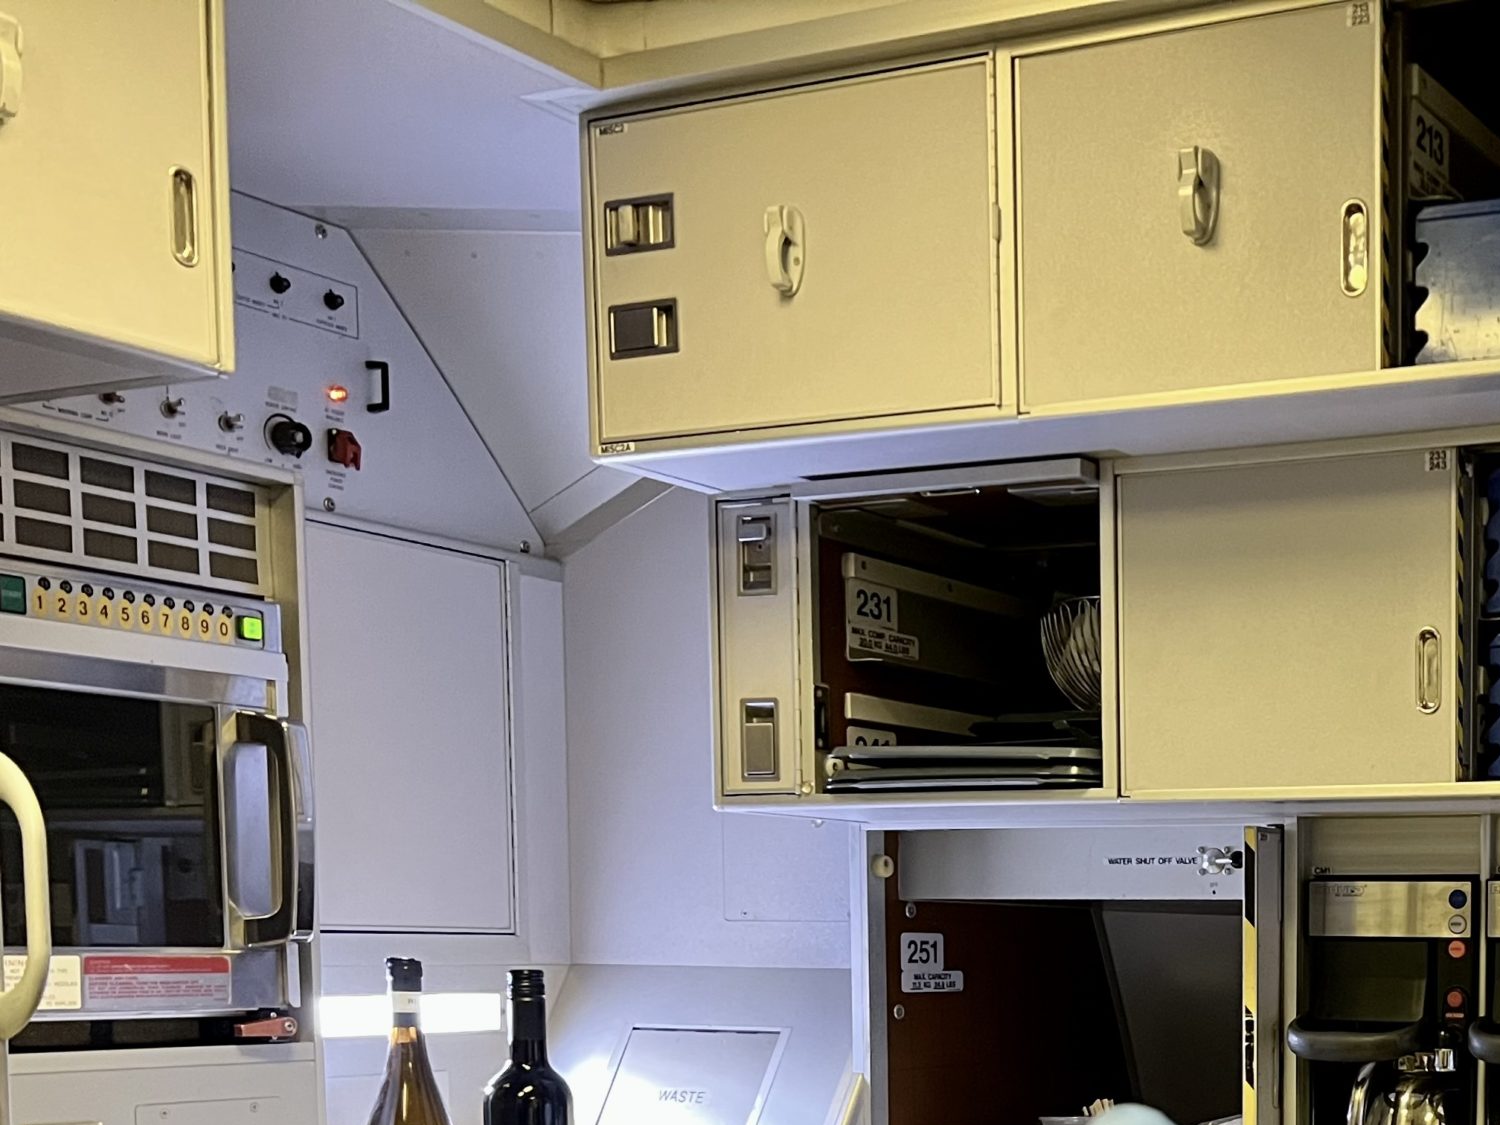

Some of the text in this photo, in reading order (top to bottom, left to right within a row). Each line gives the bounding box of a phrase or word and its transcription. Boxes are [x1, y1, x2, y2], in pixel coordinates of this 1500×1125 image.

[1416, 115, 1444, 166] 213
[1429, 450, 1447, 460] 233
[856, 588, 891, 623] 231
[37, 595, 43, 609] 1
[58, 598, 66, 613] 2
[79, 600, 88, 615] 3
[100, 605, 108, 619] 4
[121, 607, 130, 622] 5
[141, 610, 150, 624] 6
[162, 614, 170, 628] 7
[181, 616, 190, 631] 8
[200, 619, 209, 634] 9
[219, 622, 228, 636] 0
[1108, 857, 1197, 865] WATER SHUT OFF VALVE
[1314, 867, 1330, 875] CM1
[907, 940, 938, 964] 251
[659, 1089, 706, 1104] WASTE
